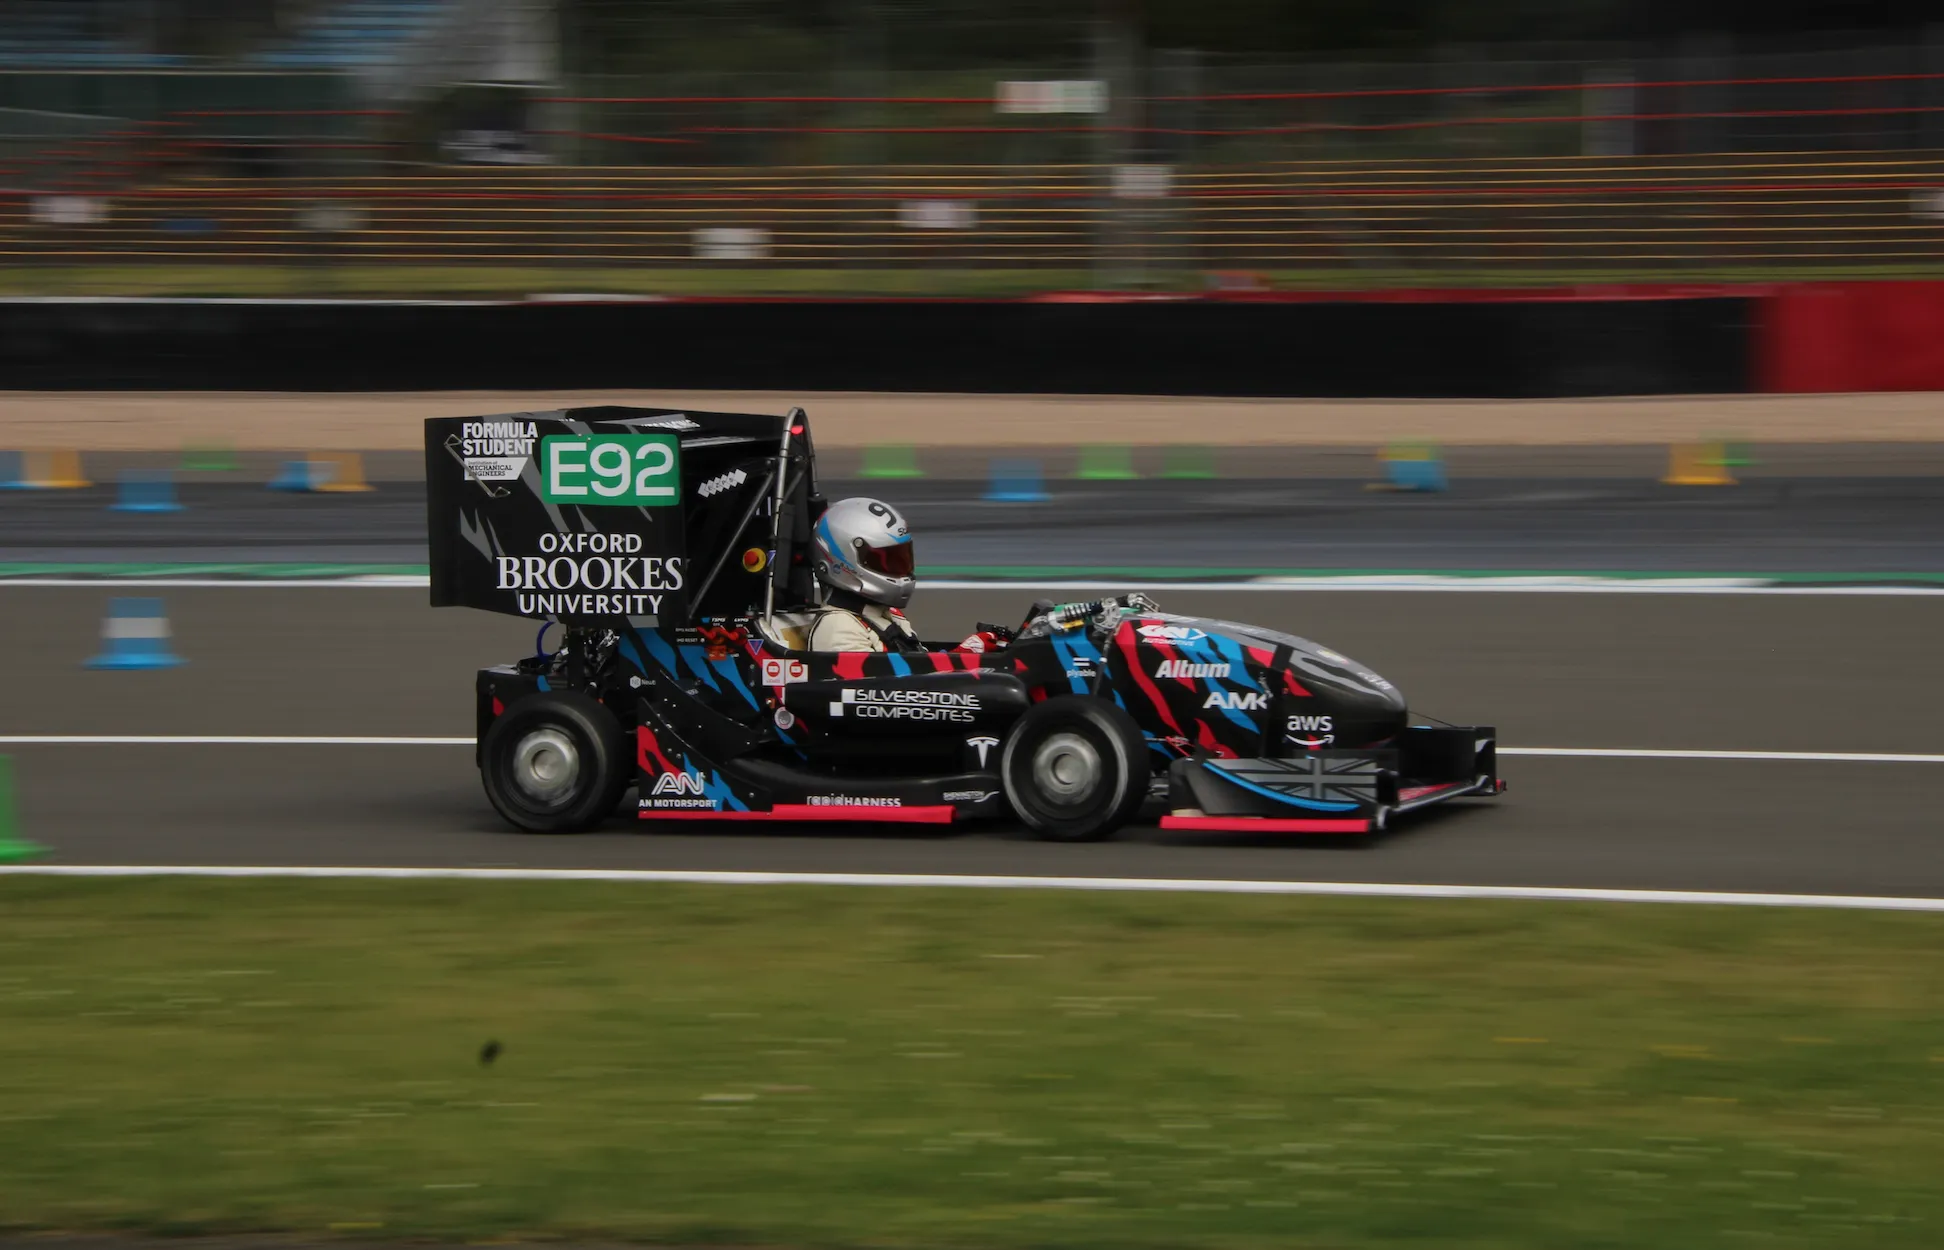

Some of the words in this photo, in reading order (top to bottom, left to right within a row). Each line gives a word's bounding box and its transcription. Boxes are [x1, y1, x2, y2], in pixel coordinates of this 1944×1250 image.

[463, 422, 538, 438] FORMULA
[463, 439, 534, 455] STUDENT
[550, 442, 675, 497] E92
[539, 533, 642, 553] OXFORD
[496, 556, 683, 590] BROOKES
[519, 594, 663, 614] UNIVERSITY
[1155, 660, 1230, 678] Altium
[857, 689, 980, 707] SILVERSTONE
[1202, 692, 1268, 710] AMK
[856, 705, 975, 722] COMPOSITES
[1287, 715, 1333, 731] aws
[654, 800, 717, 808] MOTORSPORT
